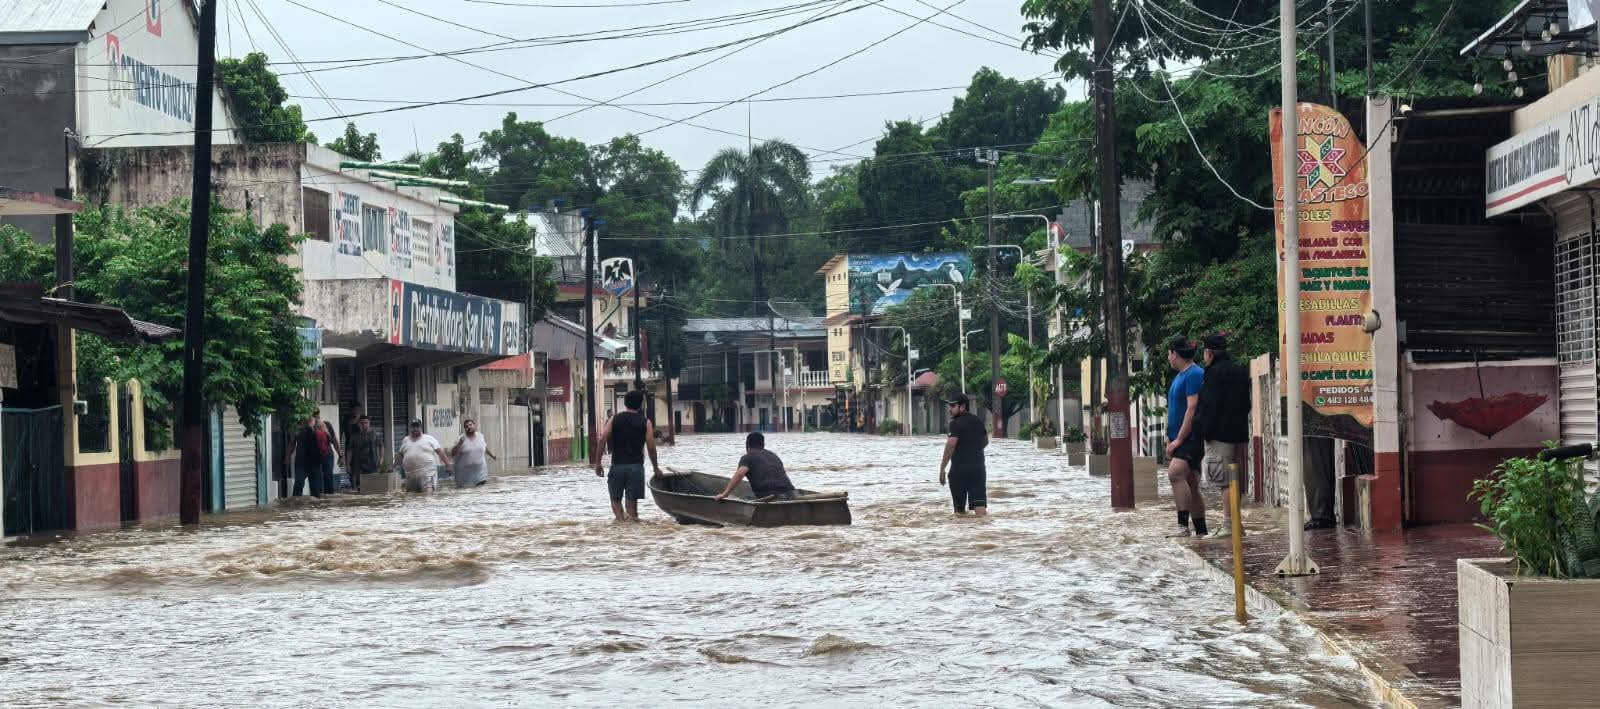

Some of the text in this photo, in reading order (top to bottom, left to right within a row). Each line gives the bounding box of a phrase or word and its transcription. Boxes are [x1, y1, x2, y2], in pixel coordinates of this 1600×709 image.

[1297, 117, 1350, 138] NCÓN
[1275, 181, 1370, 204] ASTECO
[410, 290, 463, 348] Distribuidora
[464, 301, 479, 349] San
[1325, 314, 1362, 327] FLAUT
[1319, 386, 1360, 394] PEDIDOS
[1344, 396, 1358, 404] 126
